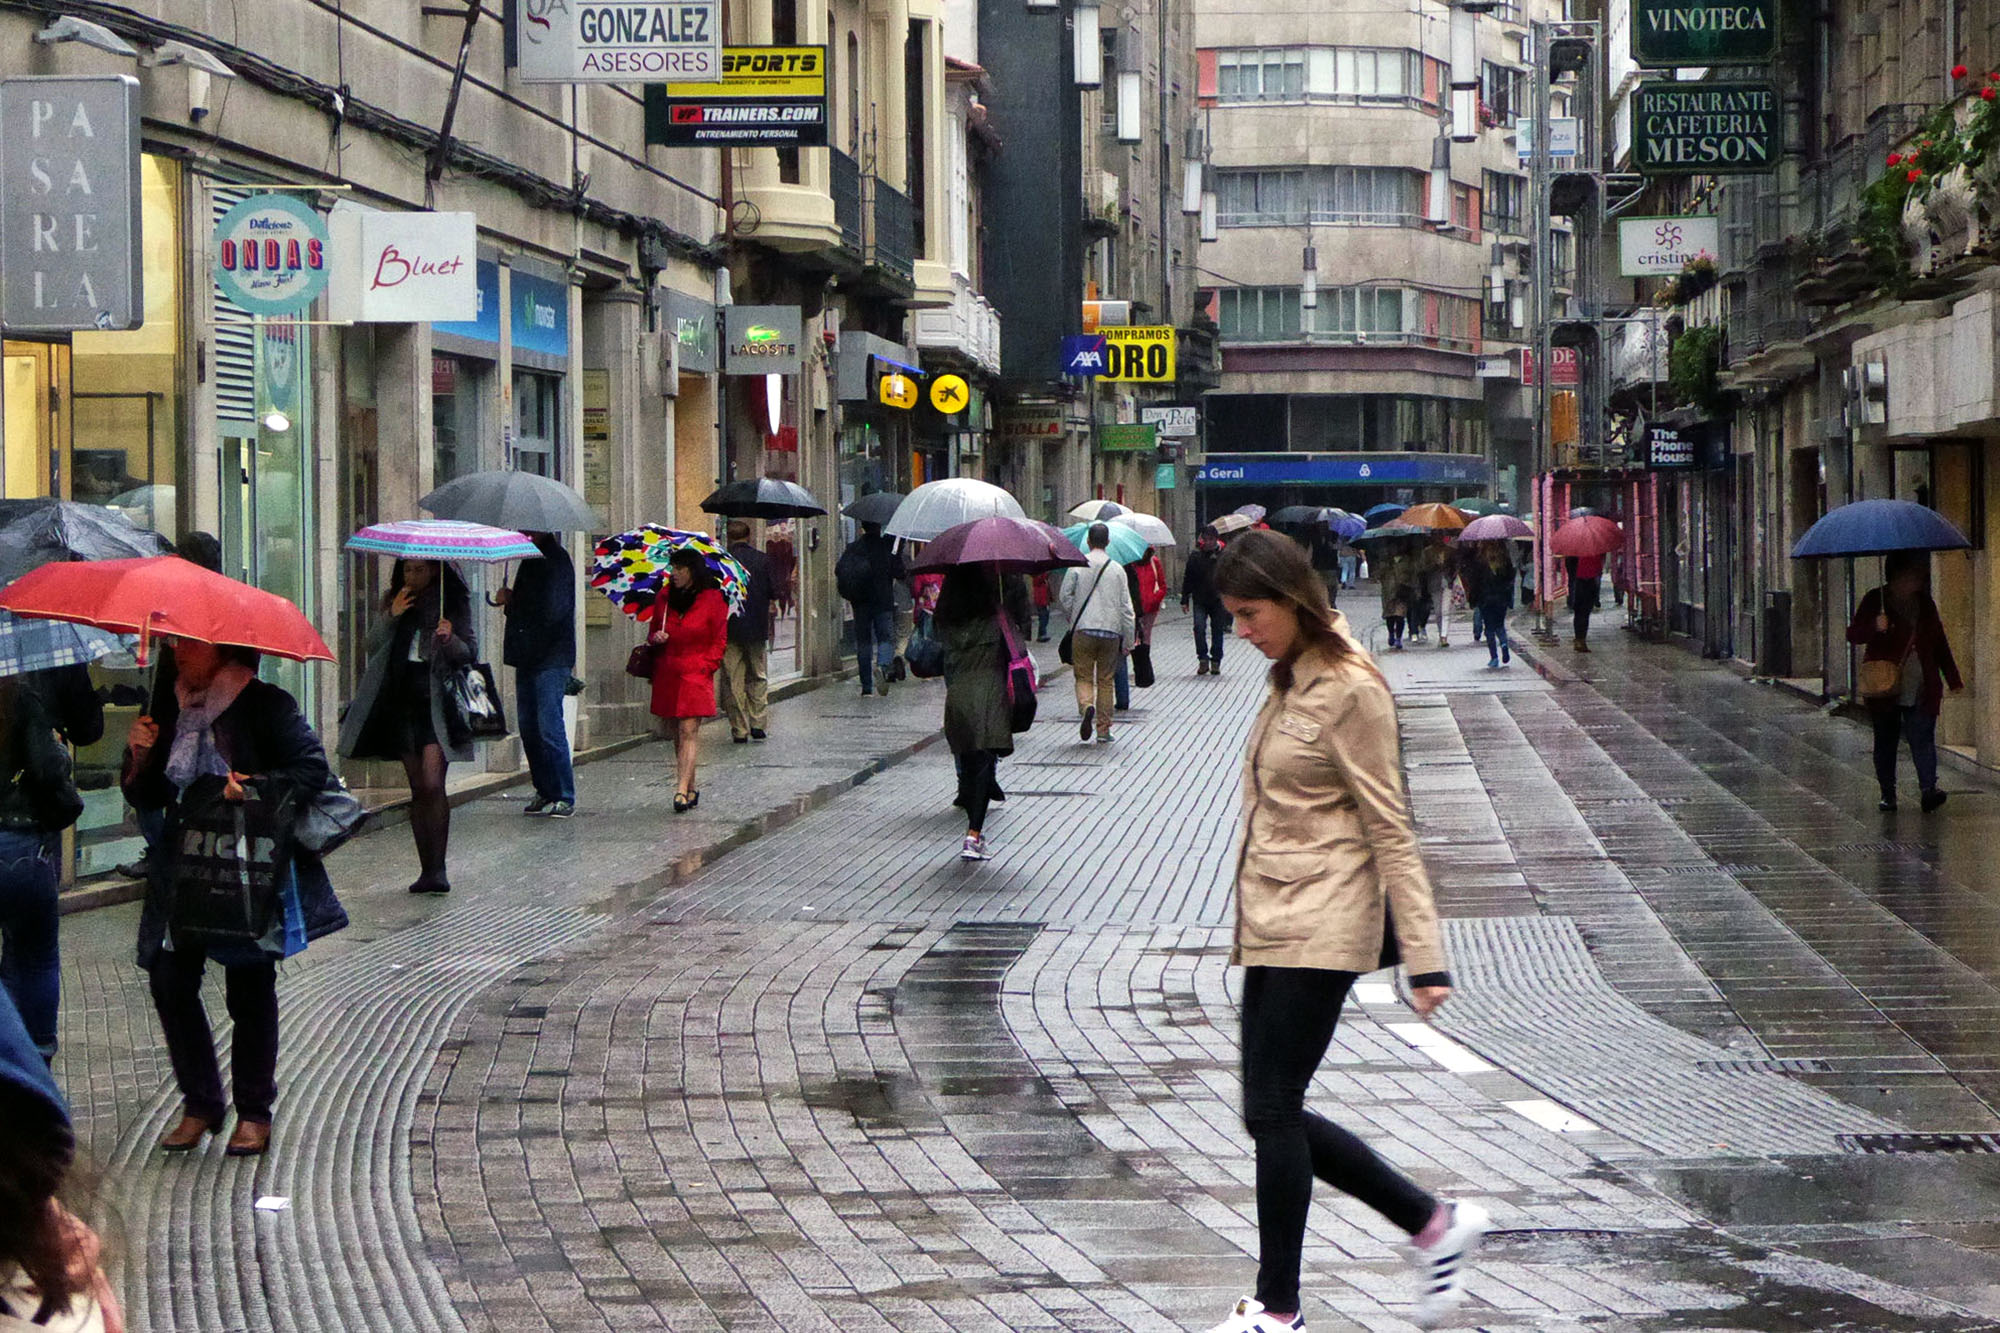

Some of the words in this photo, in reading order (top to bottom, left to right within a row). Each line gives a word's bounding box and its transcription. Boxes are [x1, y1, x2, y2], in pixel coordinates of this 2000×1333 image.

[580, 8, 708, 43] GONZALEZ
[1647, 6, 1766, 31] VINOTECA
[582, 52, 708, 72] ASESORES
[722, 55, 816, 72] SPORTS
[1643, 91, 1772, 113] RESTAURANTE
[1647, 114, 1768, 135] CAFETERIA
[695, 129, 758, 138] ENTRENAMIENTO
[759, 129, 798, 138] PERSONAL
[1646, 136, 1768, 162] MESON
[221, 238, 323, 271] ONDAS
[370, 244, 464, 290] Bluet
[1099, 330, 1170, 340] COMPRAMOS
[731, 344, 795, 356] LACOSTE
[1070, 352, 1102, 367] AXA
[1104, 344, 1167, 379] ORO
[1166, 408, 1195, 425] Pelo
[1650, 429, 1678, 439] The
[1651, 441, 1694, 451] Phone
[1651, 452, 1694, 463] House
[1210, 467, 1244, 479] Geral
